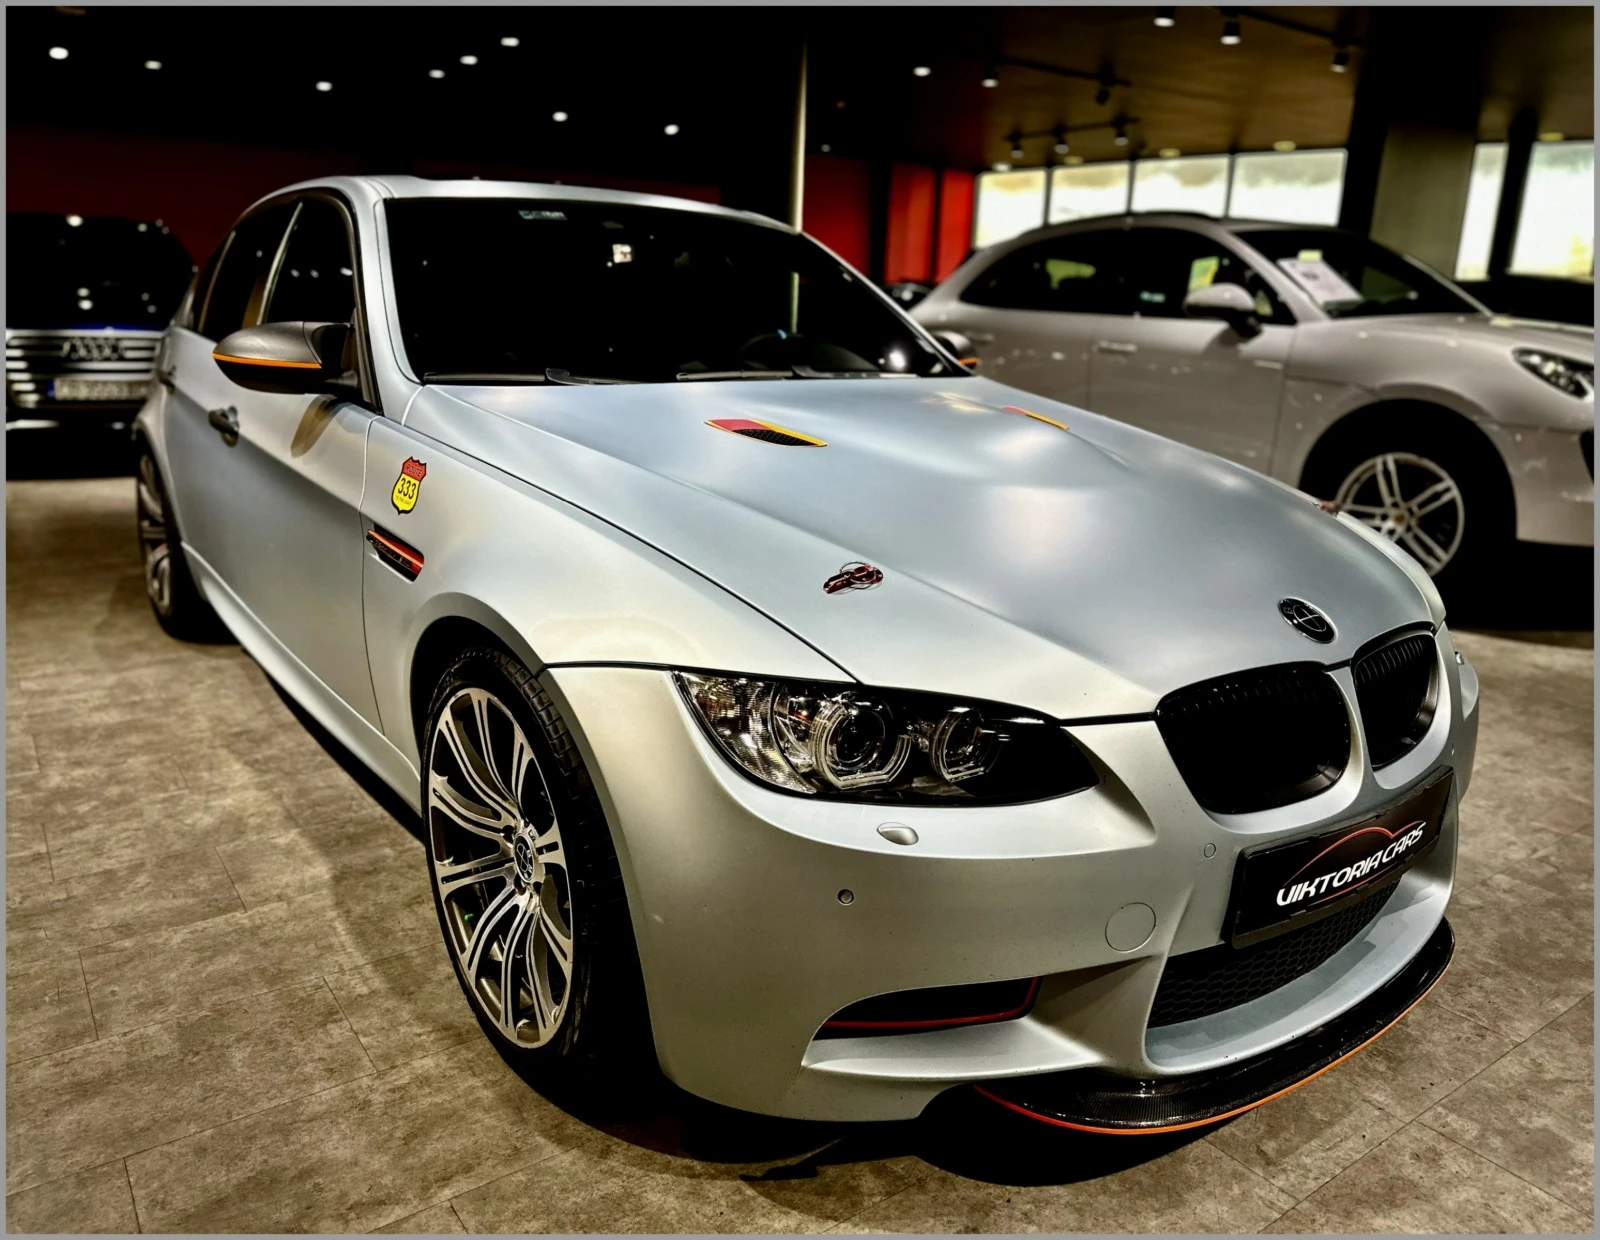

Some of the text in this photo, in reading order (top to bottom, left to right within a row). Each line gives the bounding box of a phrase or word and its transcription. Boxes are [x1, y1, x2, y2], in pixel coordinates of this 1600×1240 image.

[406, 463, 422, 477] ROUTE
[397, 477, 417, 500] 333
[1381, 821, 1427, 864] CARS
